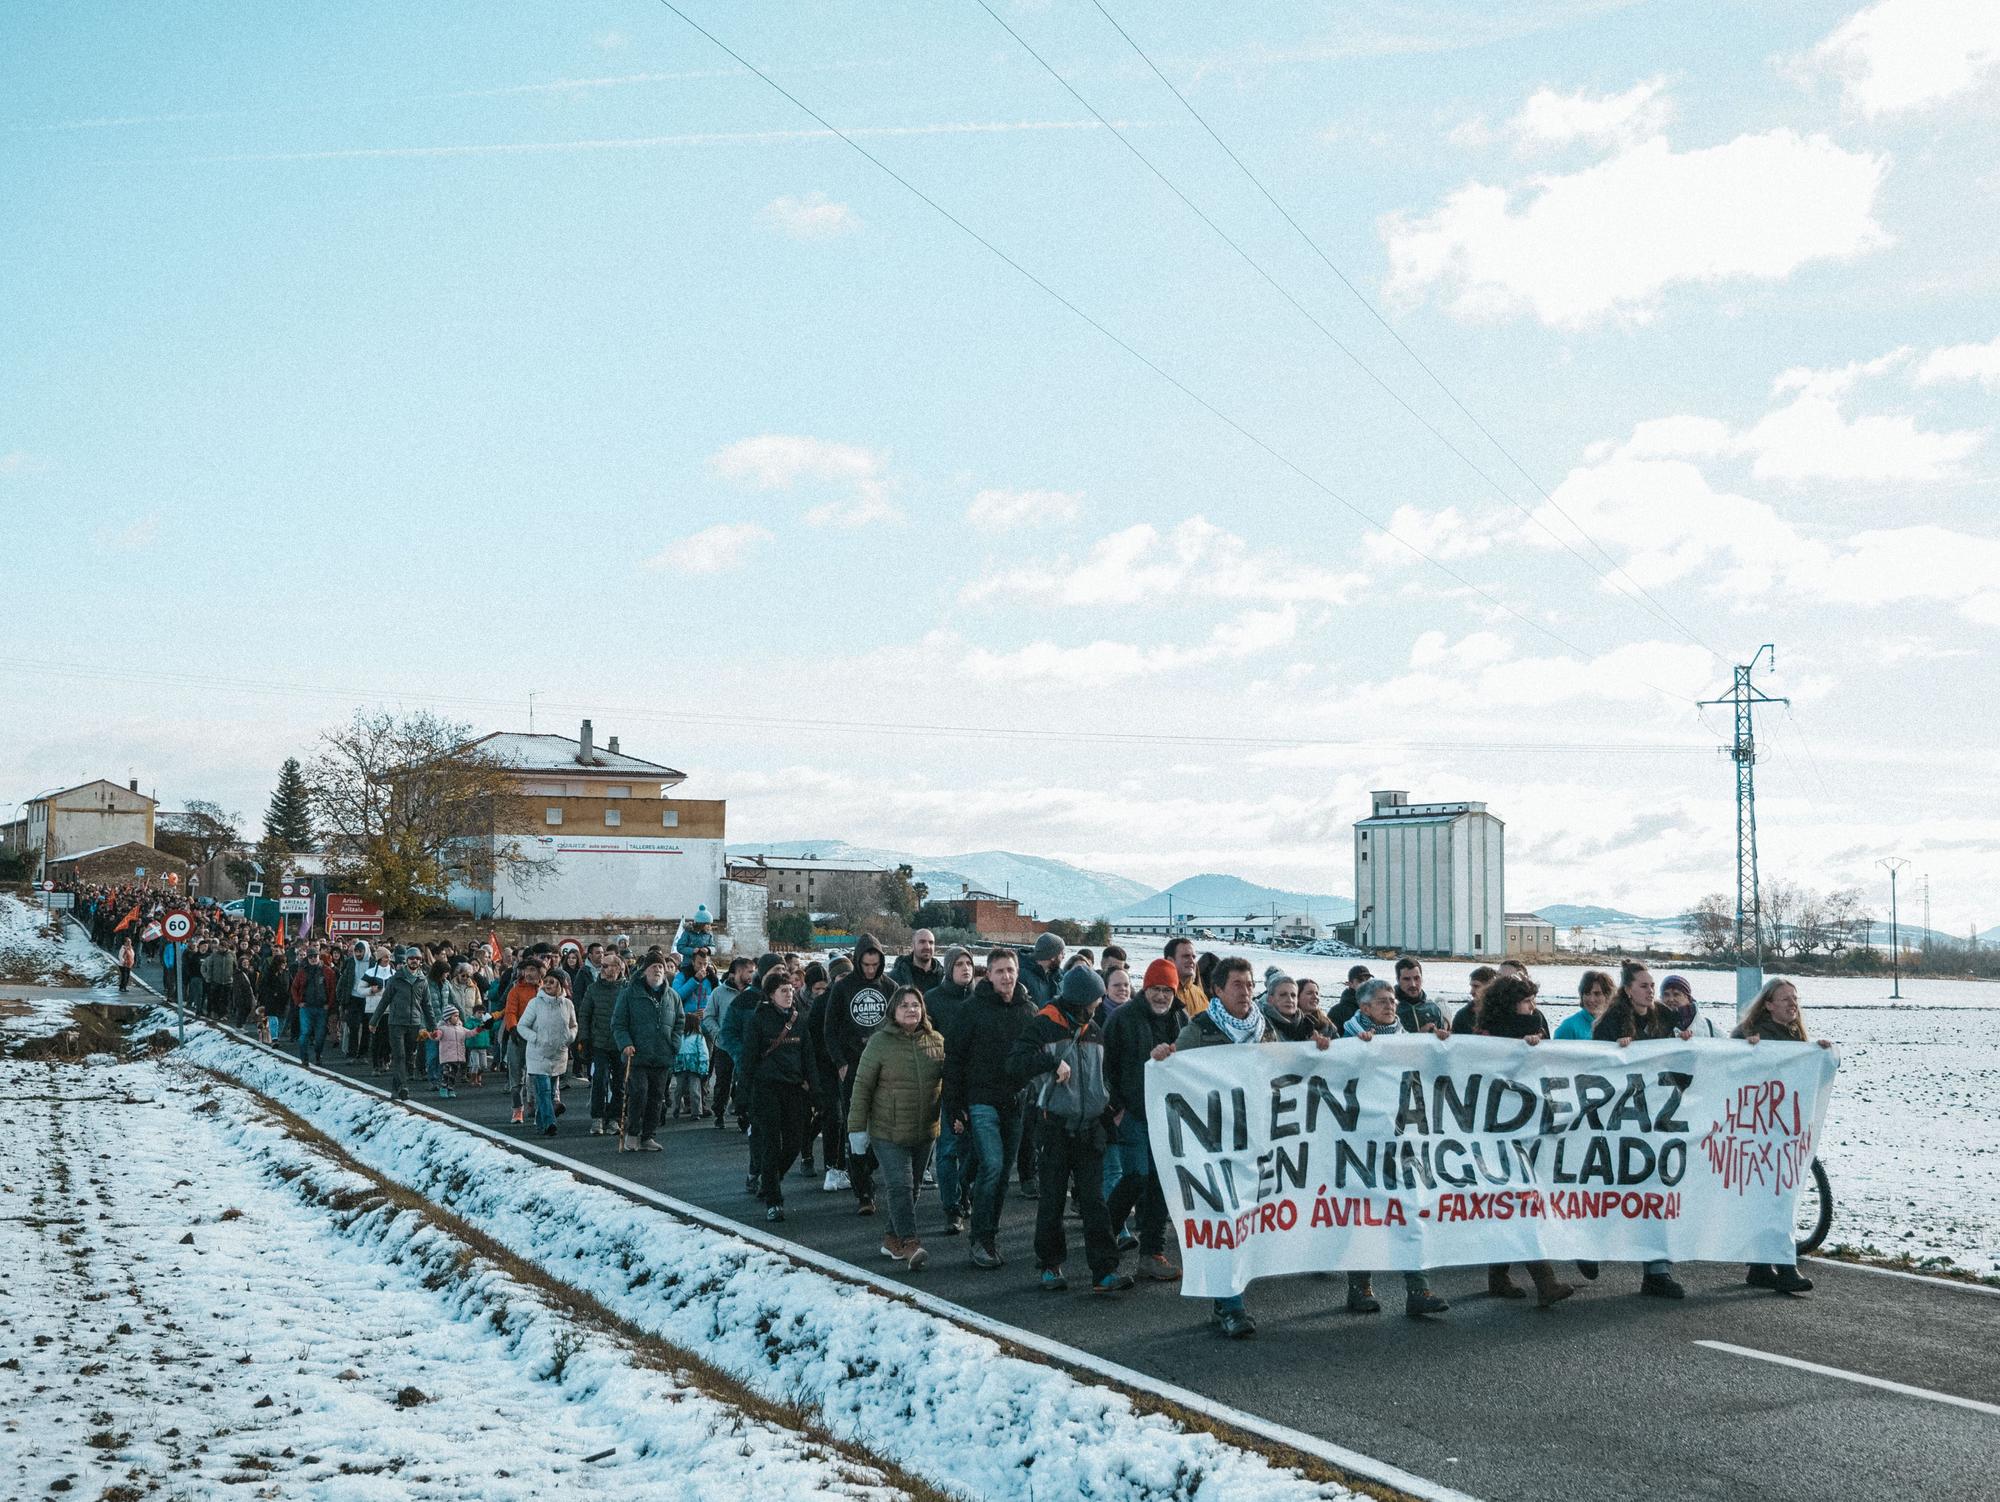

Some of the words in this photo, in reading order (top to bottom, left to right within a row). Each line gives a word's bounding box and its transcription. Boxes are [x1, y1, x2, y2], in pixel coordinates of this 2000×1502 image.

[169, 920, 186, 931] 60
[853, 1003, 885, 1013] AGAINST
[1165, 1086, 1248, 1157] NI
[1270, 1073, 1360, 1141] EN
[1394, 1070, 1693, 1136] ANDERAZ
[1174, 1158, 1240, 1213] NI
[1257, 1141, 1309, 1203] EN
[1553, 1136, 1687, 1187] LADO
[1184, 1199, 1298, 1250] MAESTRO
[1310, 1183, 1407, 1229] ÁVILA
[1437, 1190, 1546, 1223] FAXISTA
[1550, 1190, 1681, 1221] KANPORA!
